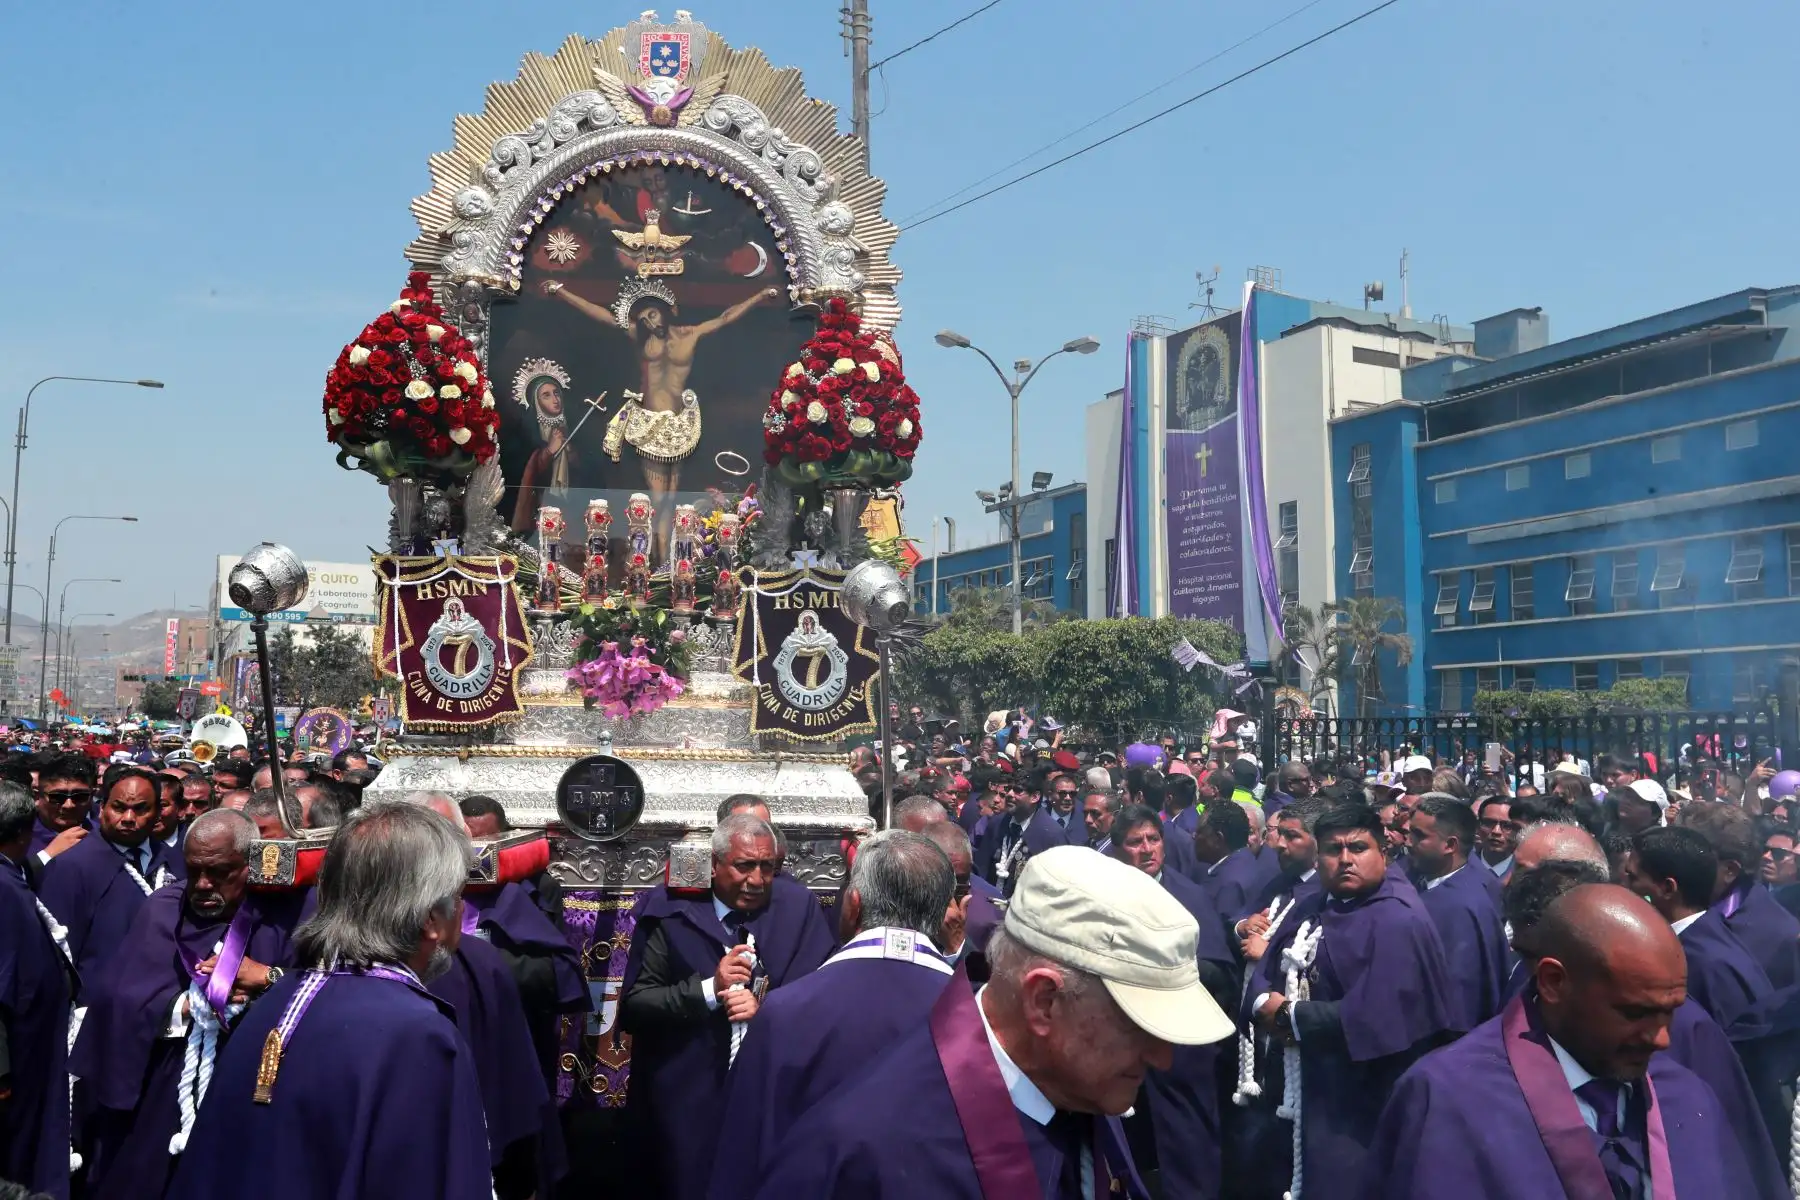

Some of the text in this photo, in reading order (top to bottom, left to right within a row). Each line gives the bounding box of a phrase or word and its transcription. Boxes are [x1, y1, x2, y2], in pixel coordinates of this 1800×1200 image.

[320, 573, 359, 585] QUITO
[1178, 575, 1204, 586] Hospital
[318, 590, 368, 598] Laboratorio
[416, 580, 488, 600] HSMN
[1173, 586, 1205, 596] Guillermo
[285, 612, 301, 621] 595
[426, 637, 437, 652] 1873
[480, 636, 493, 651] 2025
[778, 650, 788, 666] 1873
[831, 646, 846, 664] 2025
[429, 663, 491, 694] CUADRILLA
[408, 671, 432, 704] CUNA
[436, 697, 454, 712] DE
[781, 676, 843, 706] CUADRILLA
[760, 683, 781, 715] CUNA
[783, 706, 800, 724] DE
